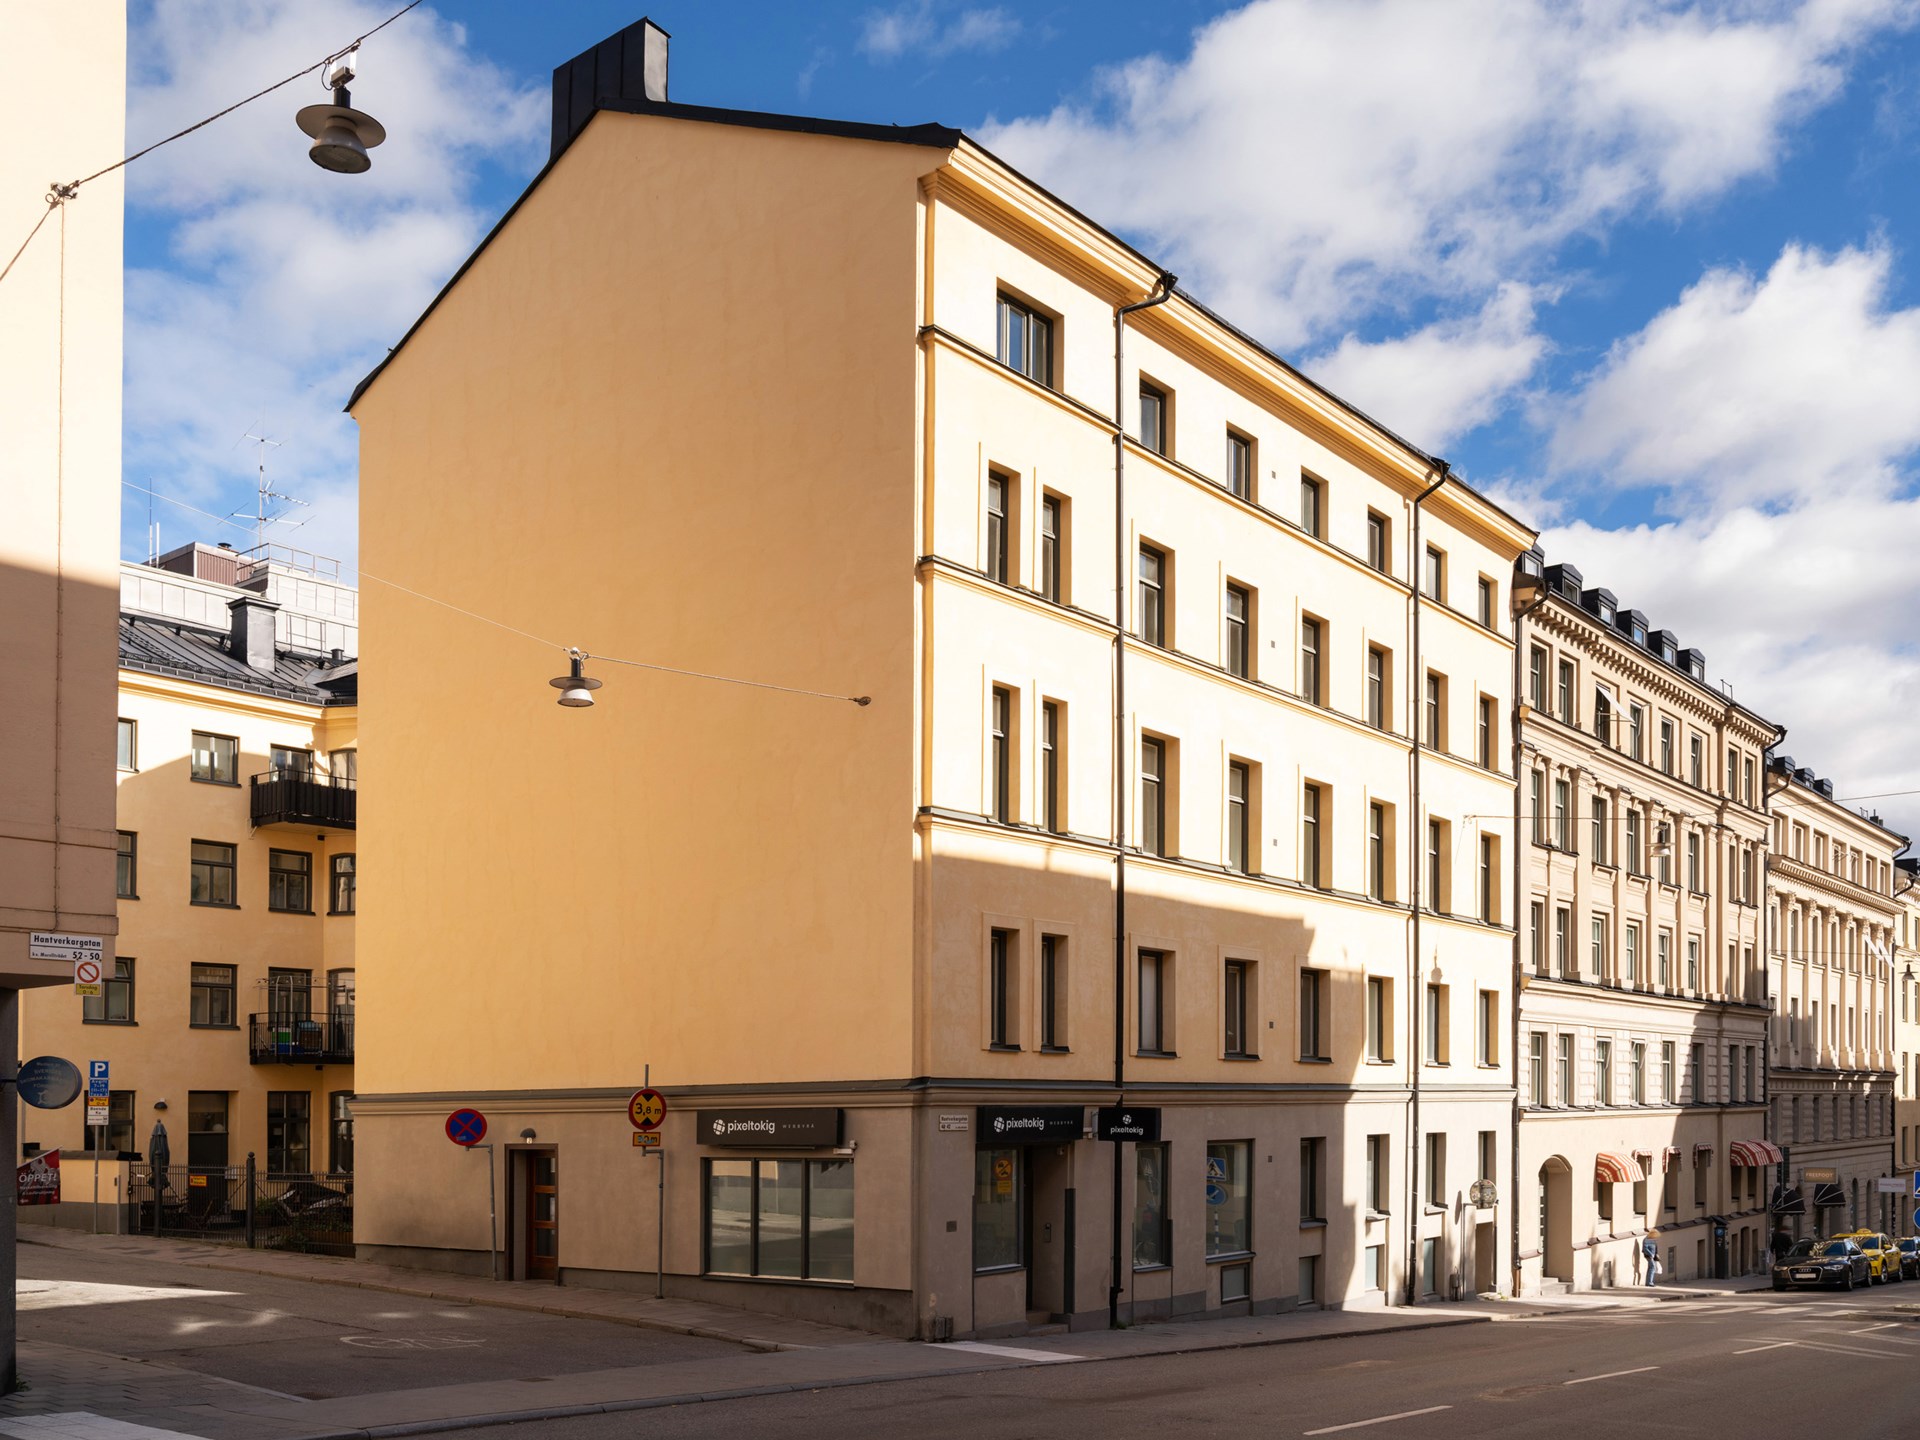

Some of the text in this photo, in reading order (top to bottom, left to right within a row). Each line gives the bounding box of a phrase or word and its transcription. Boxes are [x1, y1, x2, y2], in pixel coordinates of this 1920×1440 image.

[34, 935, 101, 947] Hantverkargatan
[94, 1062, 106, 1077] P
[635, 1102, 652, 1116] 3,8
[727, 1119, 776, 1134] pixeltokig
[1006, 1117, 1045, 1131] pixeltokig
[1110, 1126, 1144, 1136] pixeltokig
[19, 1172, 57, 1183] ÖPPET!
